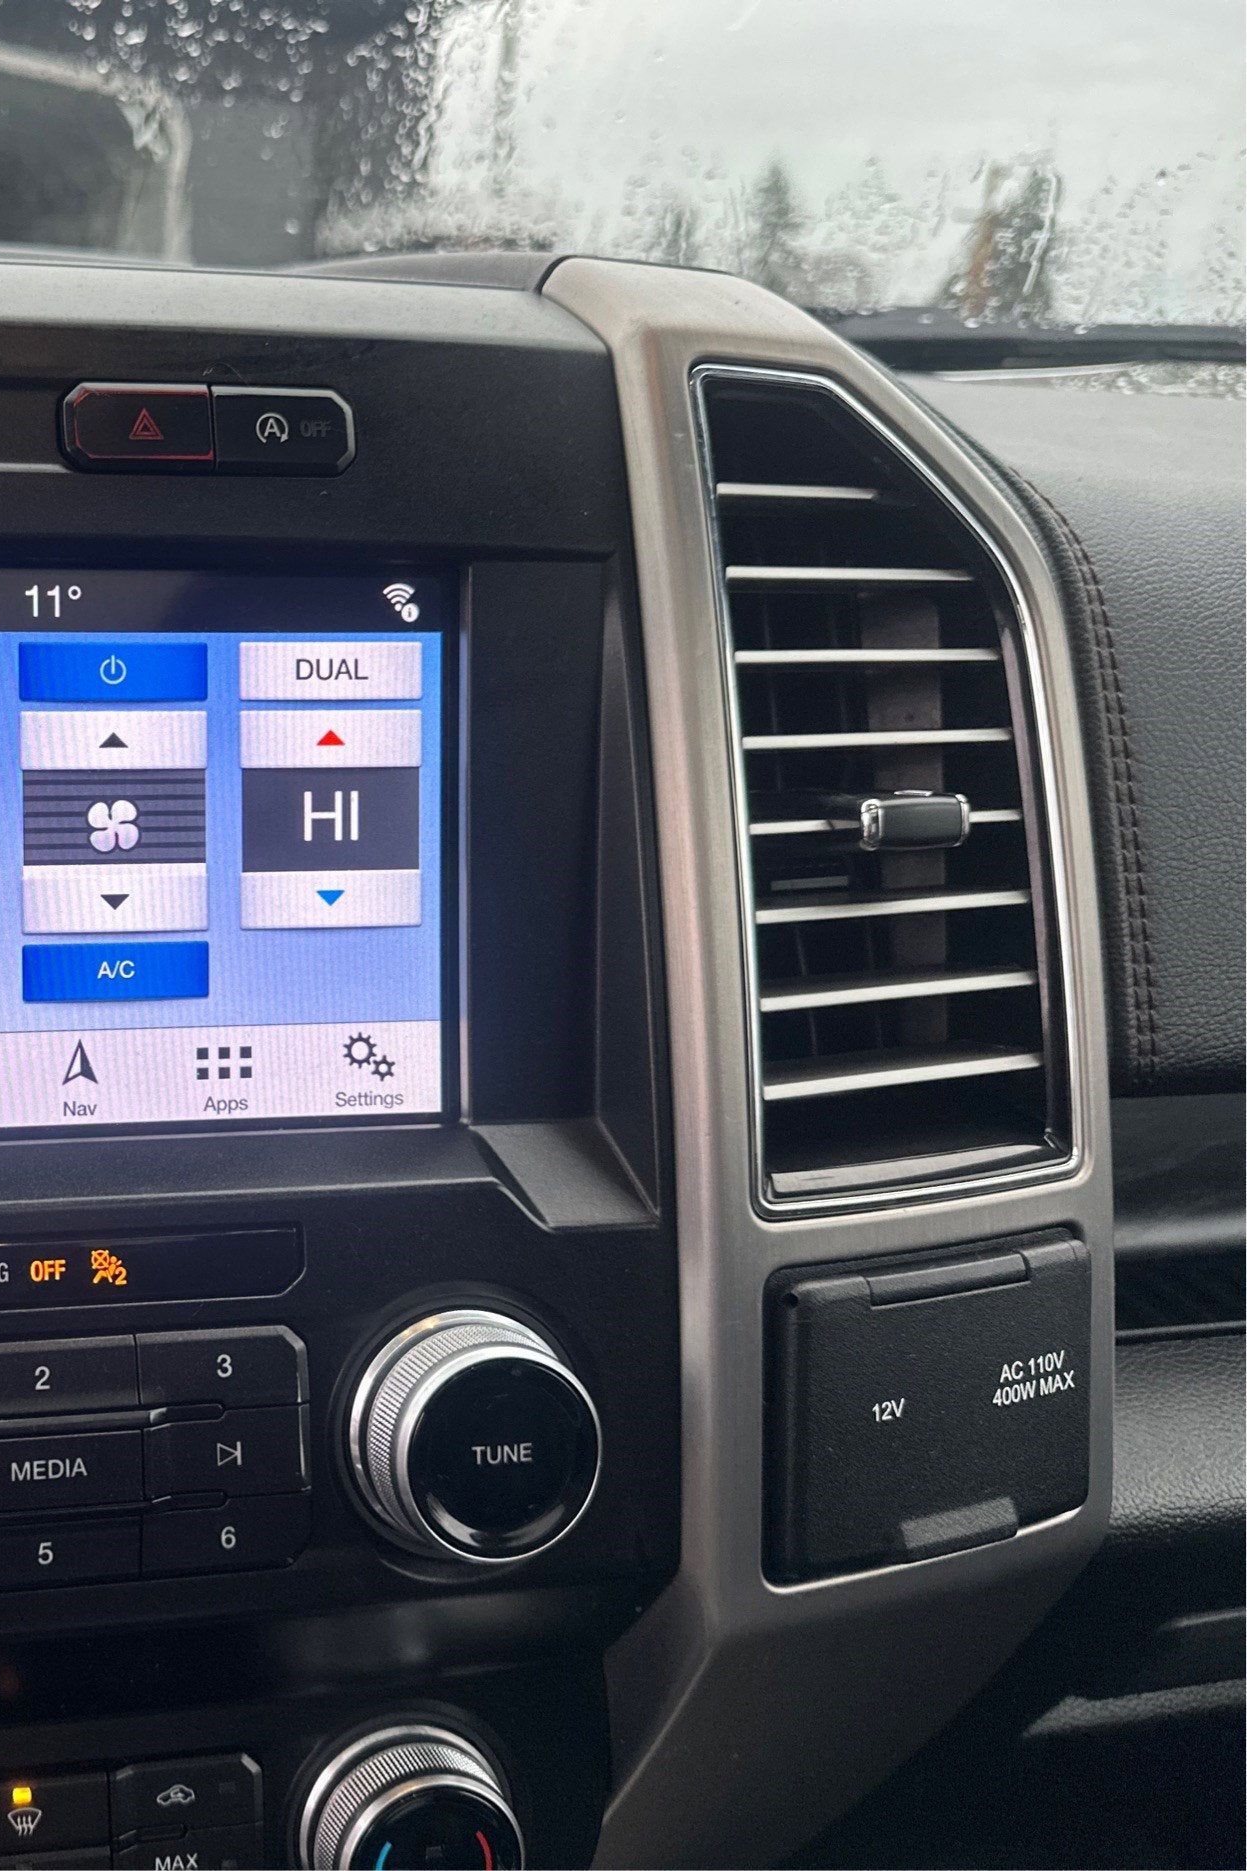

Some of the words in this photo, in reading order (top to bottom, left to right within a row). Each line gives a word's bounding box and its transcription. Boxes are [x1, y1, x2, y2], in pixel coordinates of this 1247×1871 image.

[300, 420, 331, 438] OFF
[295, 658, 369, 681] DUAL
[303, 790, 360, 842] HI
[97, 960, 136, 980] A/C
[63, 1101, 98, 1118] Nav
[203, 1096, 249, 1113] Apps
[334, 1090, 405, 1109] Settings
[30, 1259, 66, 1282] OFF
[216, 1354, 234, 1377] 3
[1000, 1361, 1024, 1383] AC
[1028, 1350, 1065, 1377] 110V
[34, 1366, 51, 1390] 2
[992, 1381, 1037, 1407] 400W
[1039, 1370, 1075, 1396] MAX
[872, 1398, 905, 1422] 12V
[471, 1442, 533, 1466] TUNE
[10, 1457, 88, 1482] MEDIA
[220, 1525, 237, 1549] 6
[37, 1541, 54, 1565] 5
[155, 1853, 198, 1871] MAX
